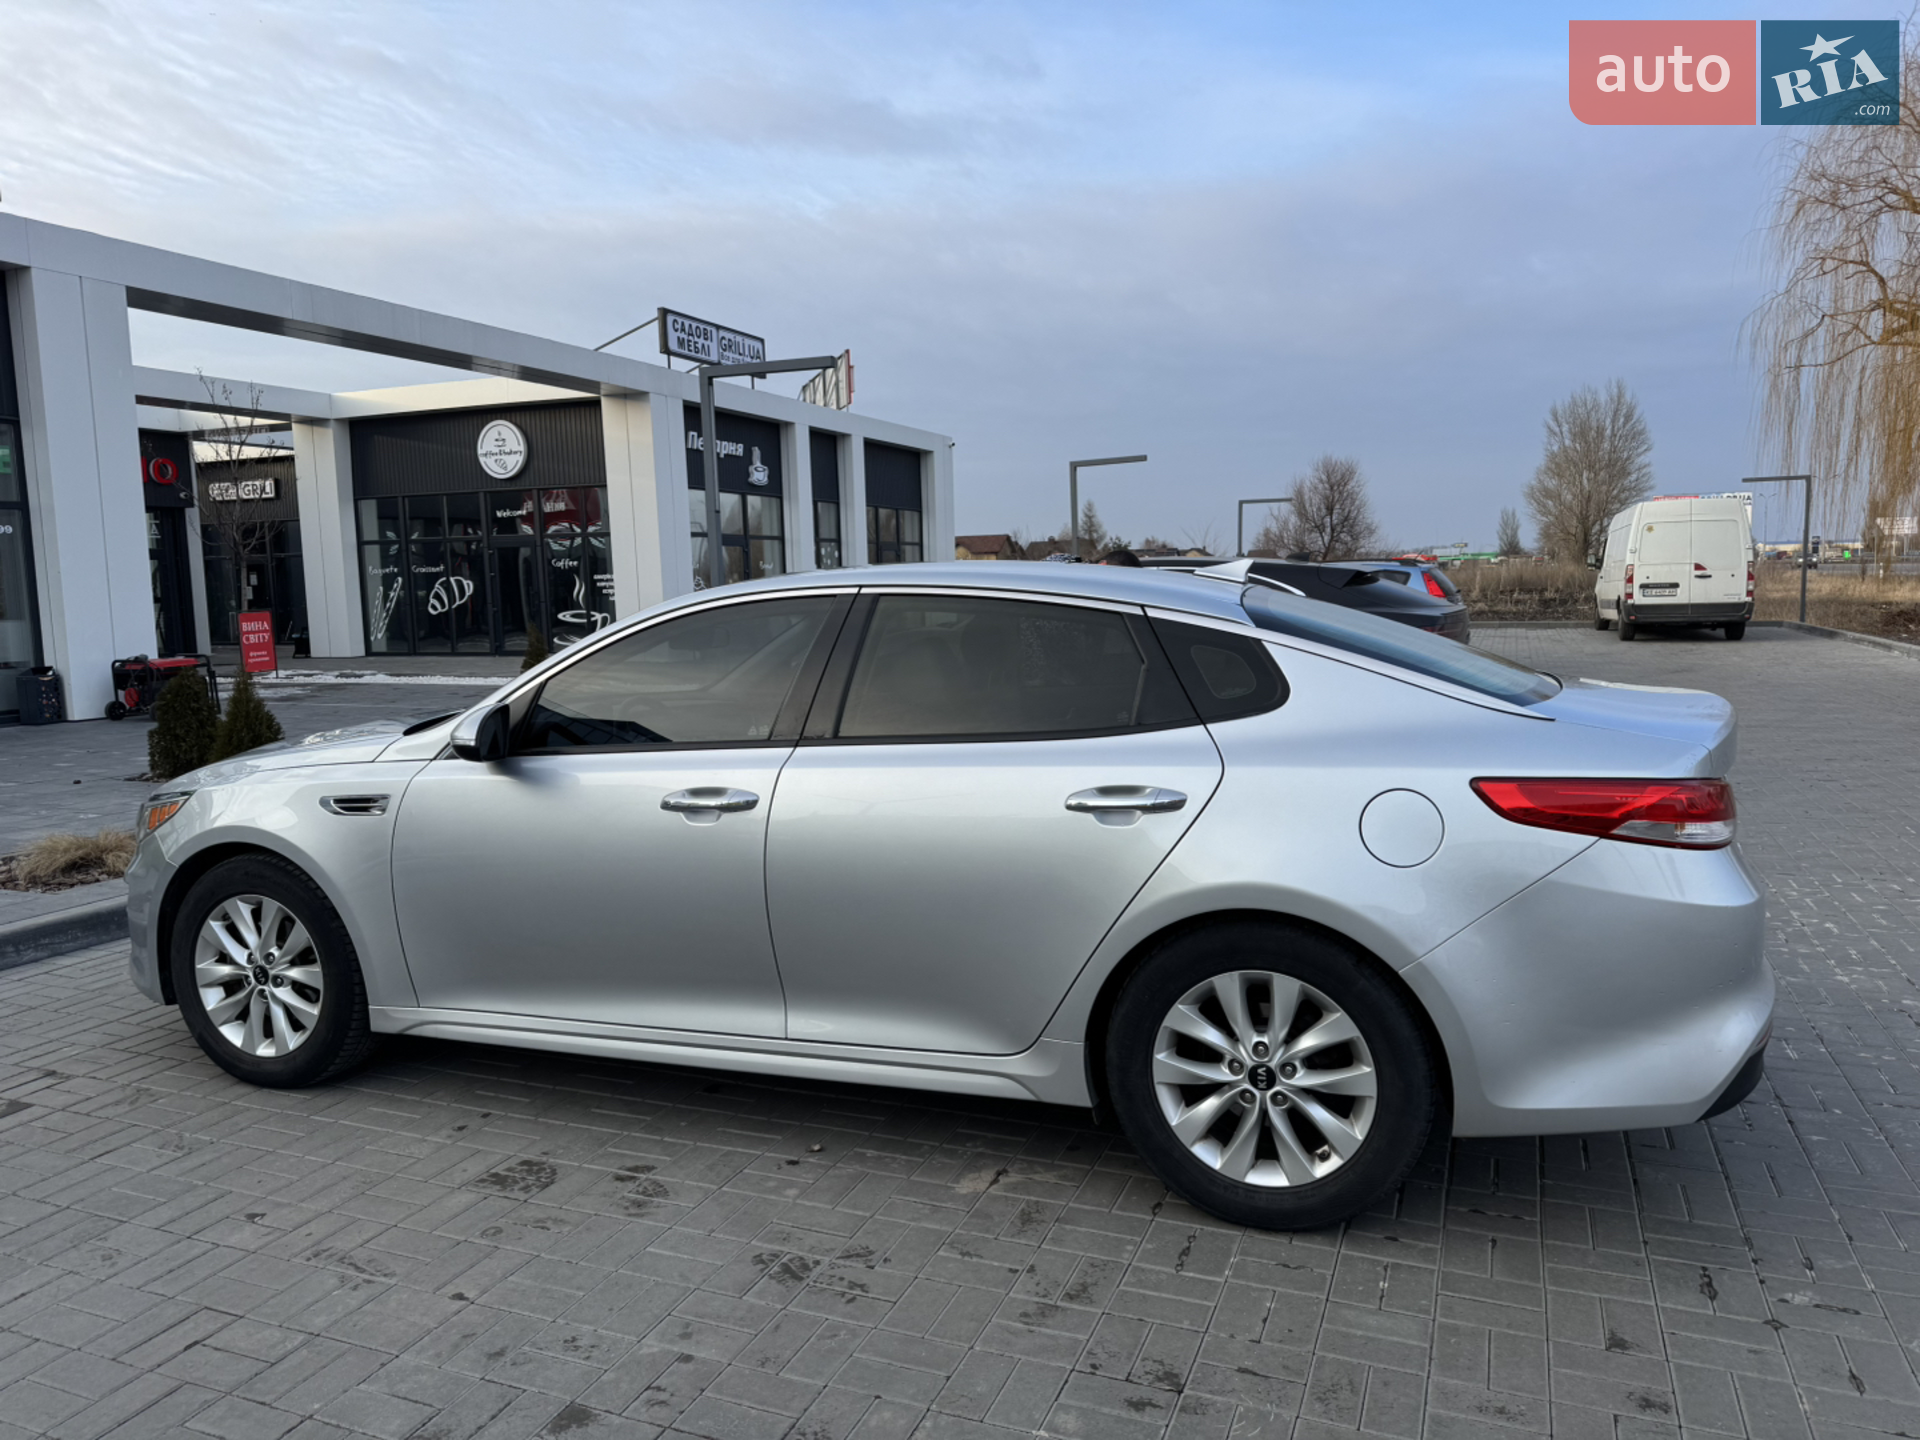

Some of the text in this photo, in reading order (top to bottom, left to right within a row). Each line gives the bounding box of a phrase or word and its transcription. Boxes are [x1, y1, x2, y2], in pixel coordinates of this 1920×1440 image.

[672, 318, 713, 343] САДОВІ
[677, 335, 711, 358] МЕБЛІ
[687, 431, 744, 458] Перня
[551, 558, 579, 570] Coffee
[241, 620, 270, 632] ВИНА
[242, 632, 270, 645] СВІТУ
[1256, 1067, 1267, 1089] KIA
